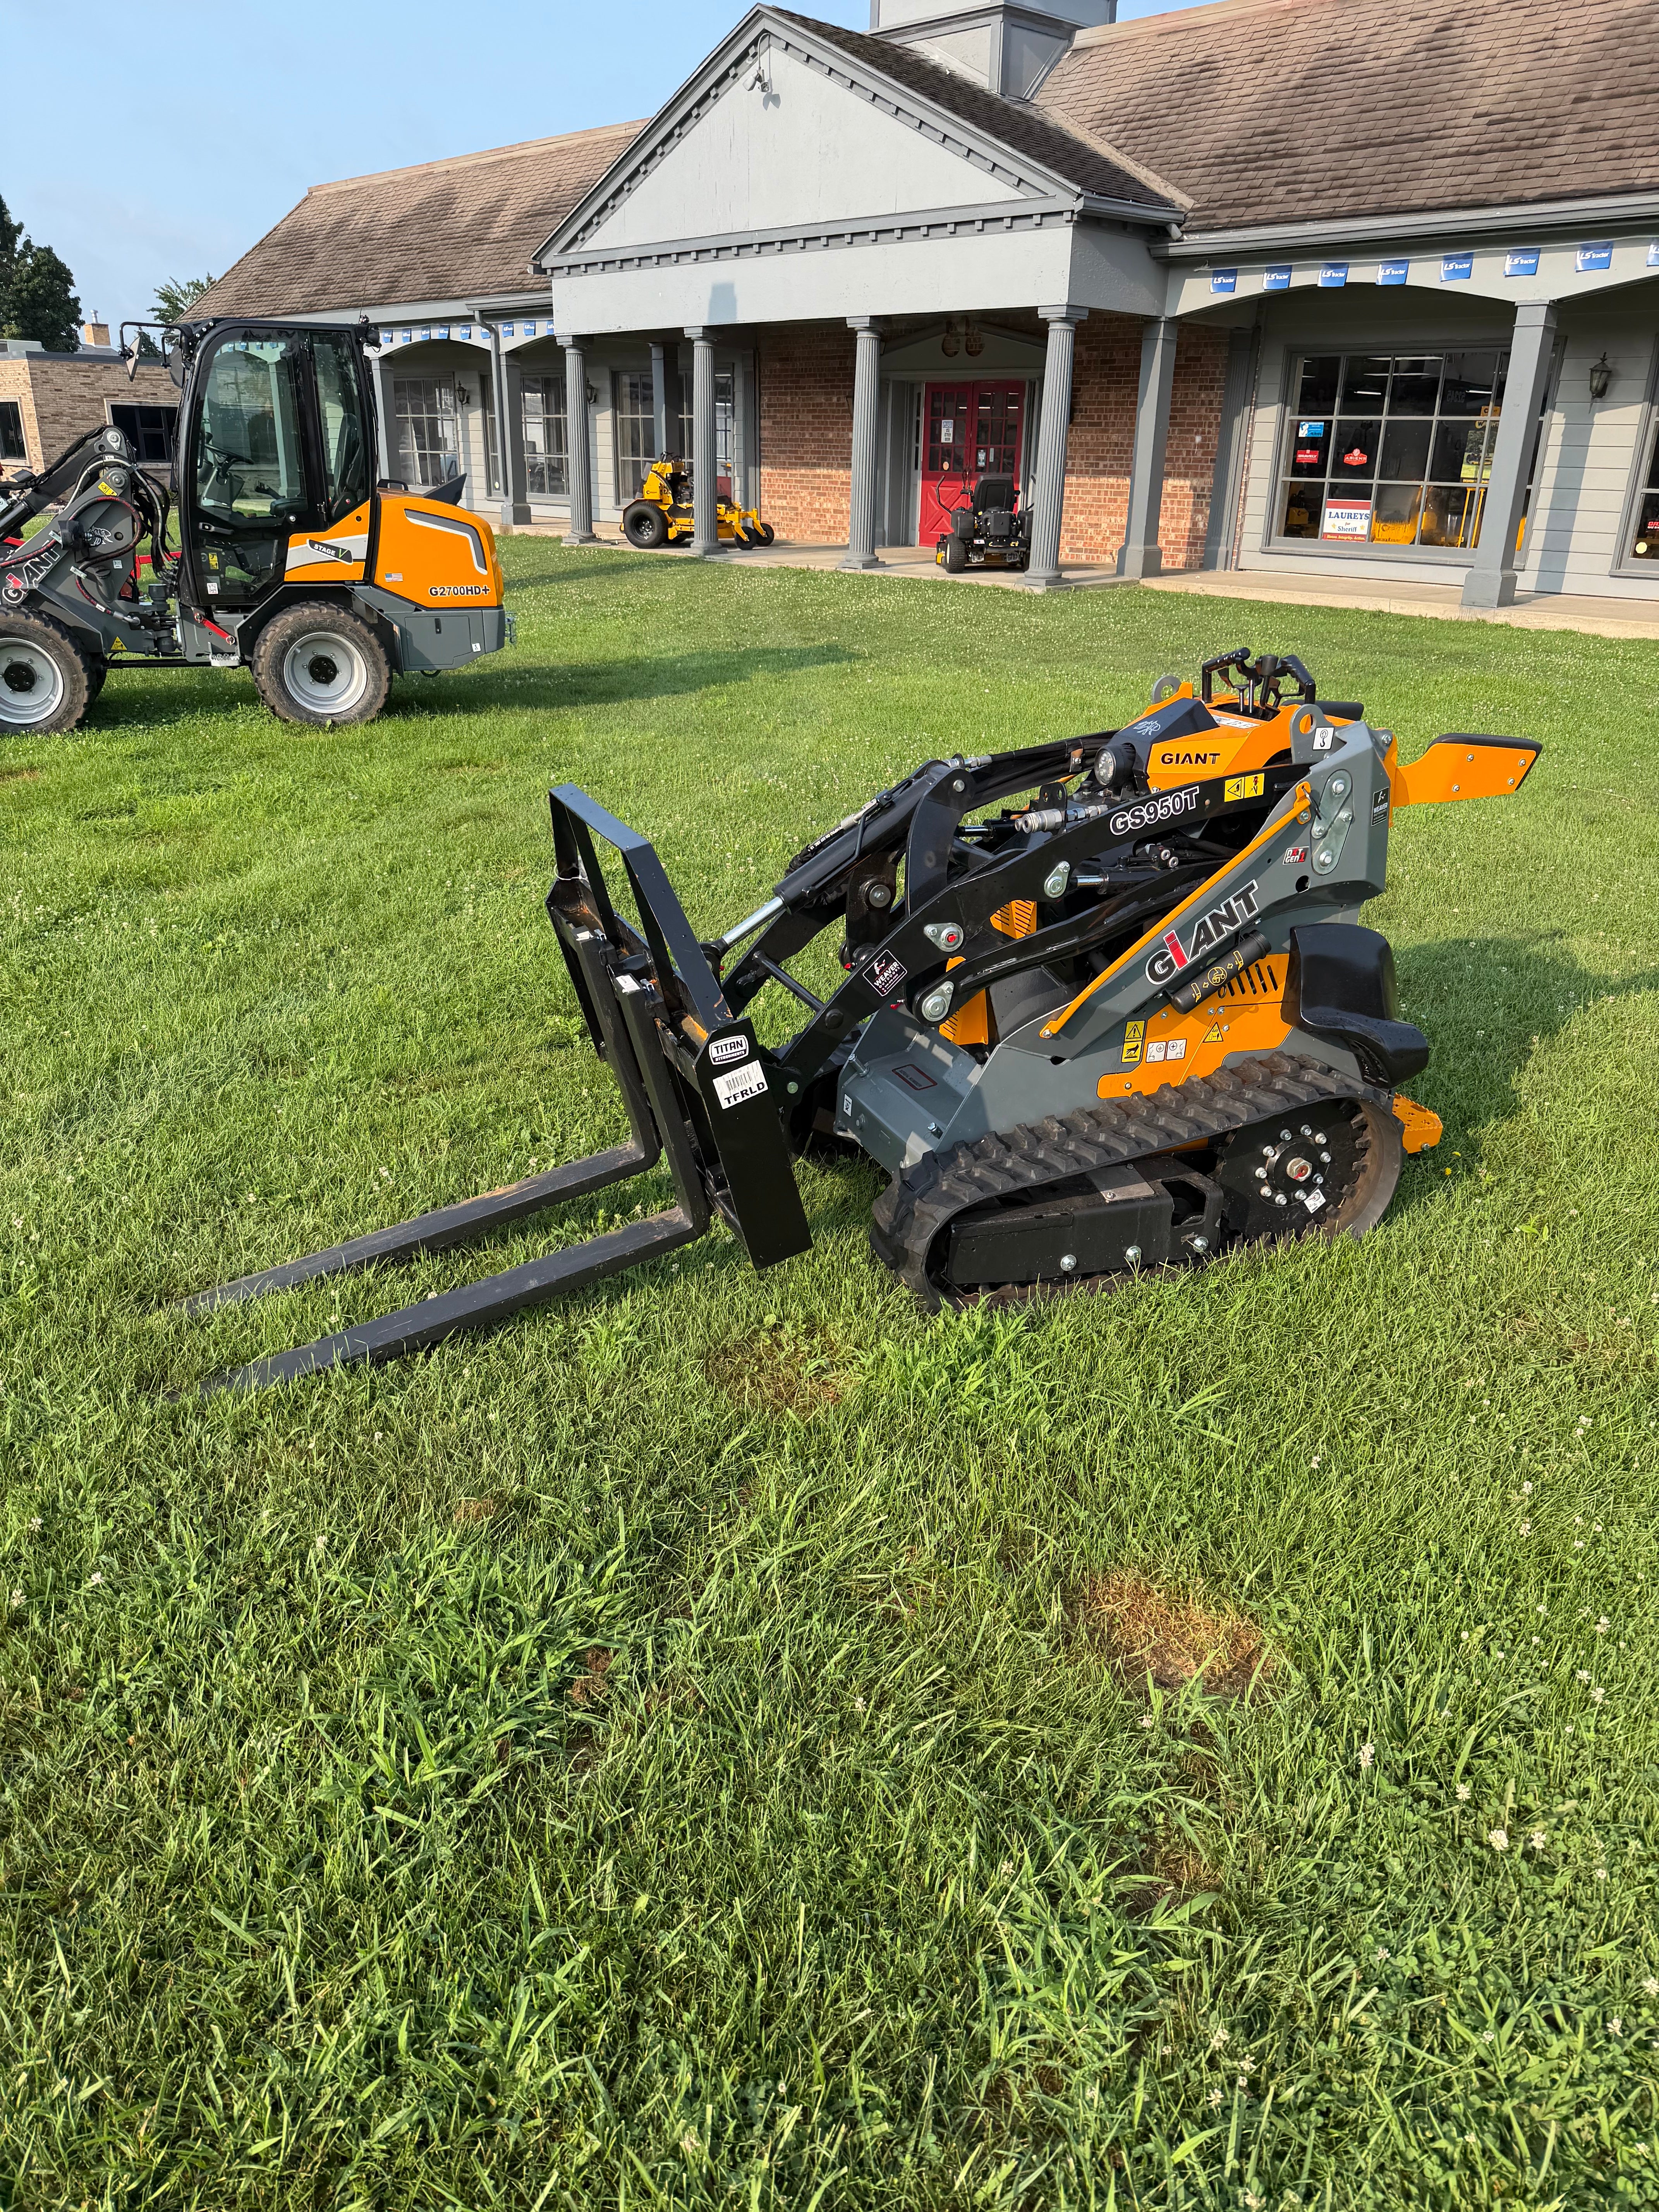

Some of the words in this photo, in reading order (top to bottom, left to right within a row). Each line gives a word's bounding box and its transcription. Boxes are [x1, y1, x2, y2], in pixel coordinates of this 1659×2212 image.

[1580, 251, 1594, 259] LS
[1328, 512, 1370, 520] LAUREYS
[314, 544, 335, 556] STAGE
[339, 548, 348, 558] V
[2, 540, 60, 603] GIANT
[429, 585, 490, 596] G2700HD+
[1161, 753, 1220, 764] GIANT
[1110, 786, 1199, 835] GS950T
[1146, 879, 1258, 984] GIANT
[874, 962, 899, 986] WEAVER
[879, 967, 900, 988] OUTDOORS
[714, 1040, 743, 1054] TITAN
[724, 1082, 765, 1104] TFRLD
